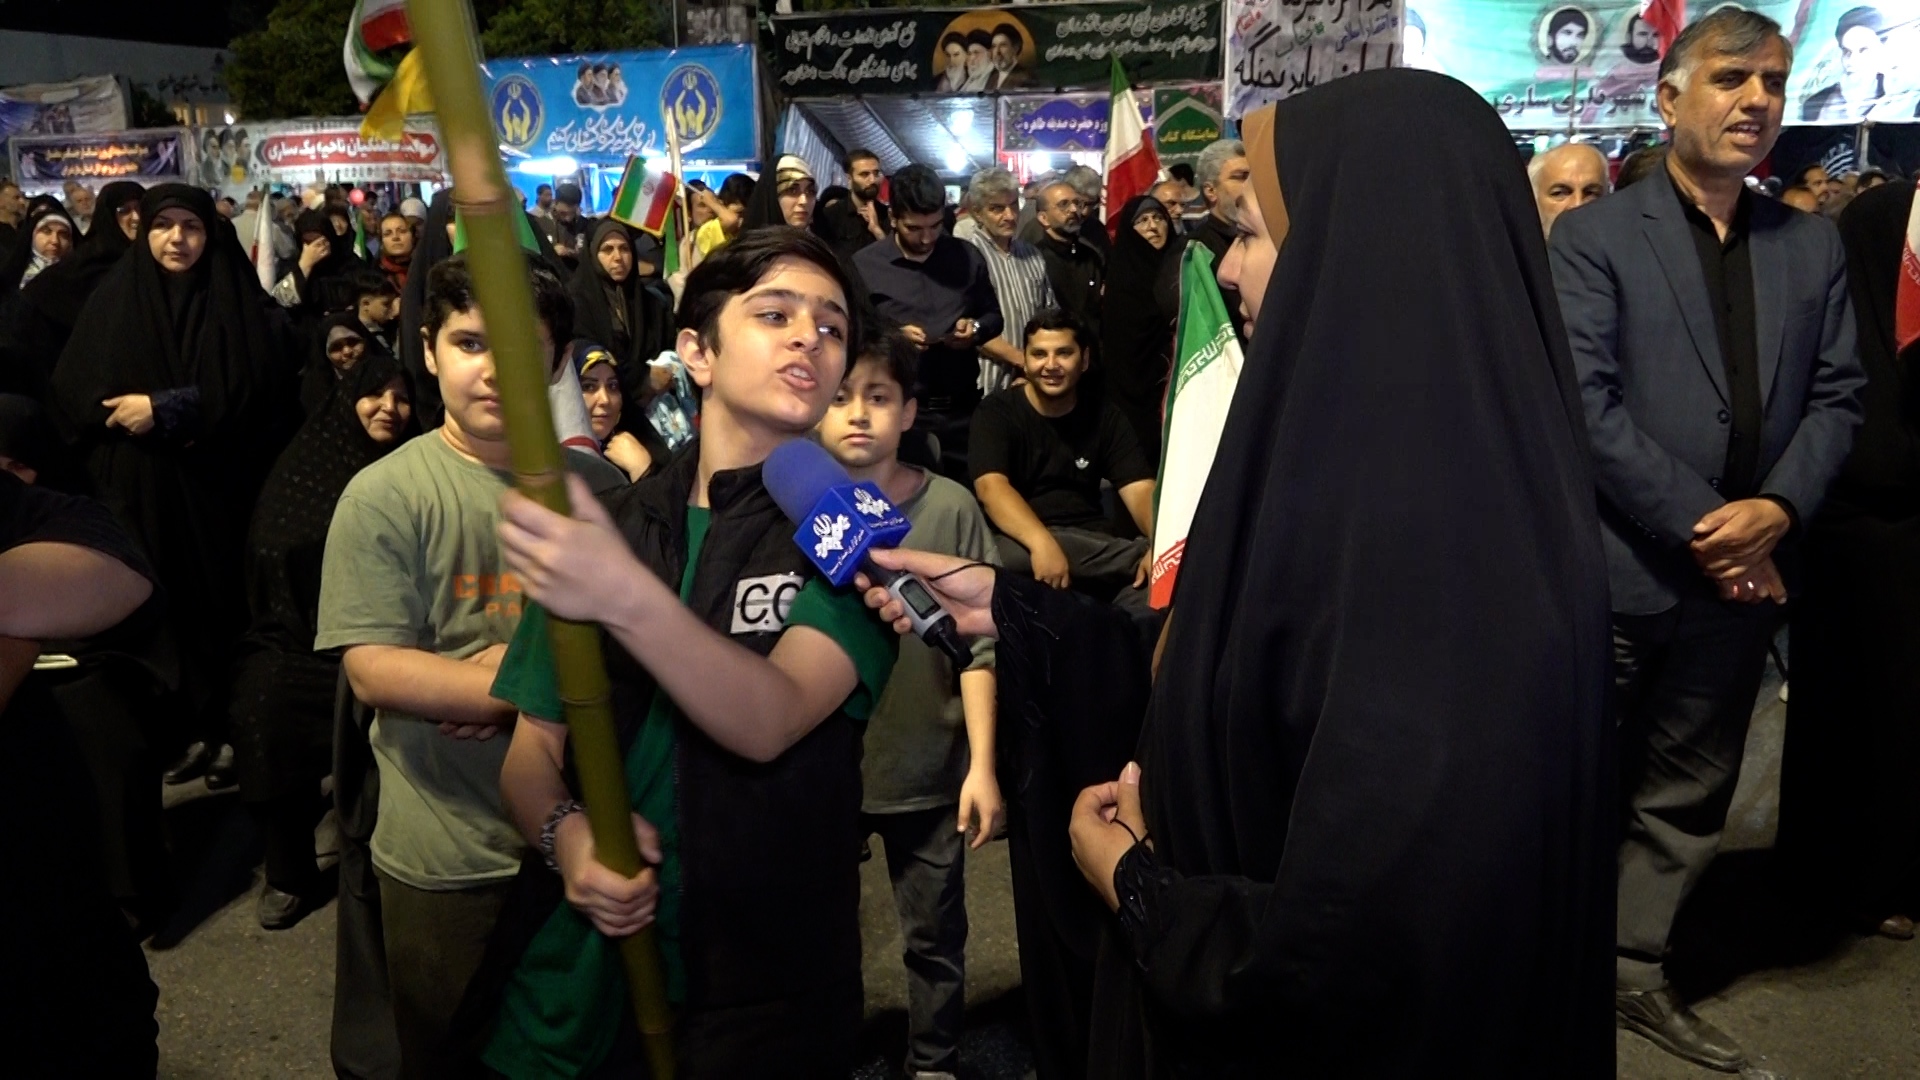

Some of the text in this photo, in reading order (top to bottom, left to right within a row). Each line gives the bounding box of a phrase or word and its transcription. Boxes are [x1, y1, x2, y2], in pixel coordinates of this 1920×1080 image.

[1498, 84, 1550, 115] ساری
[317, 138, 346, 159] ناحیه
[547, 119, 576, 153] کنیم
[268, 141, 298, 162] ساری
